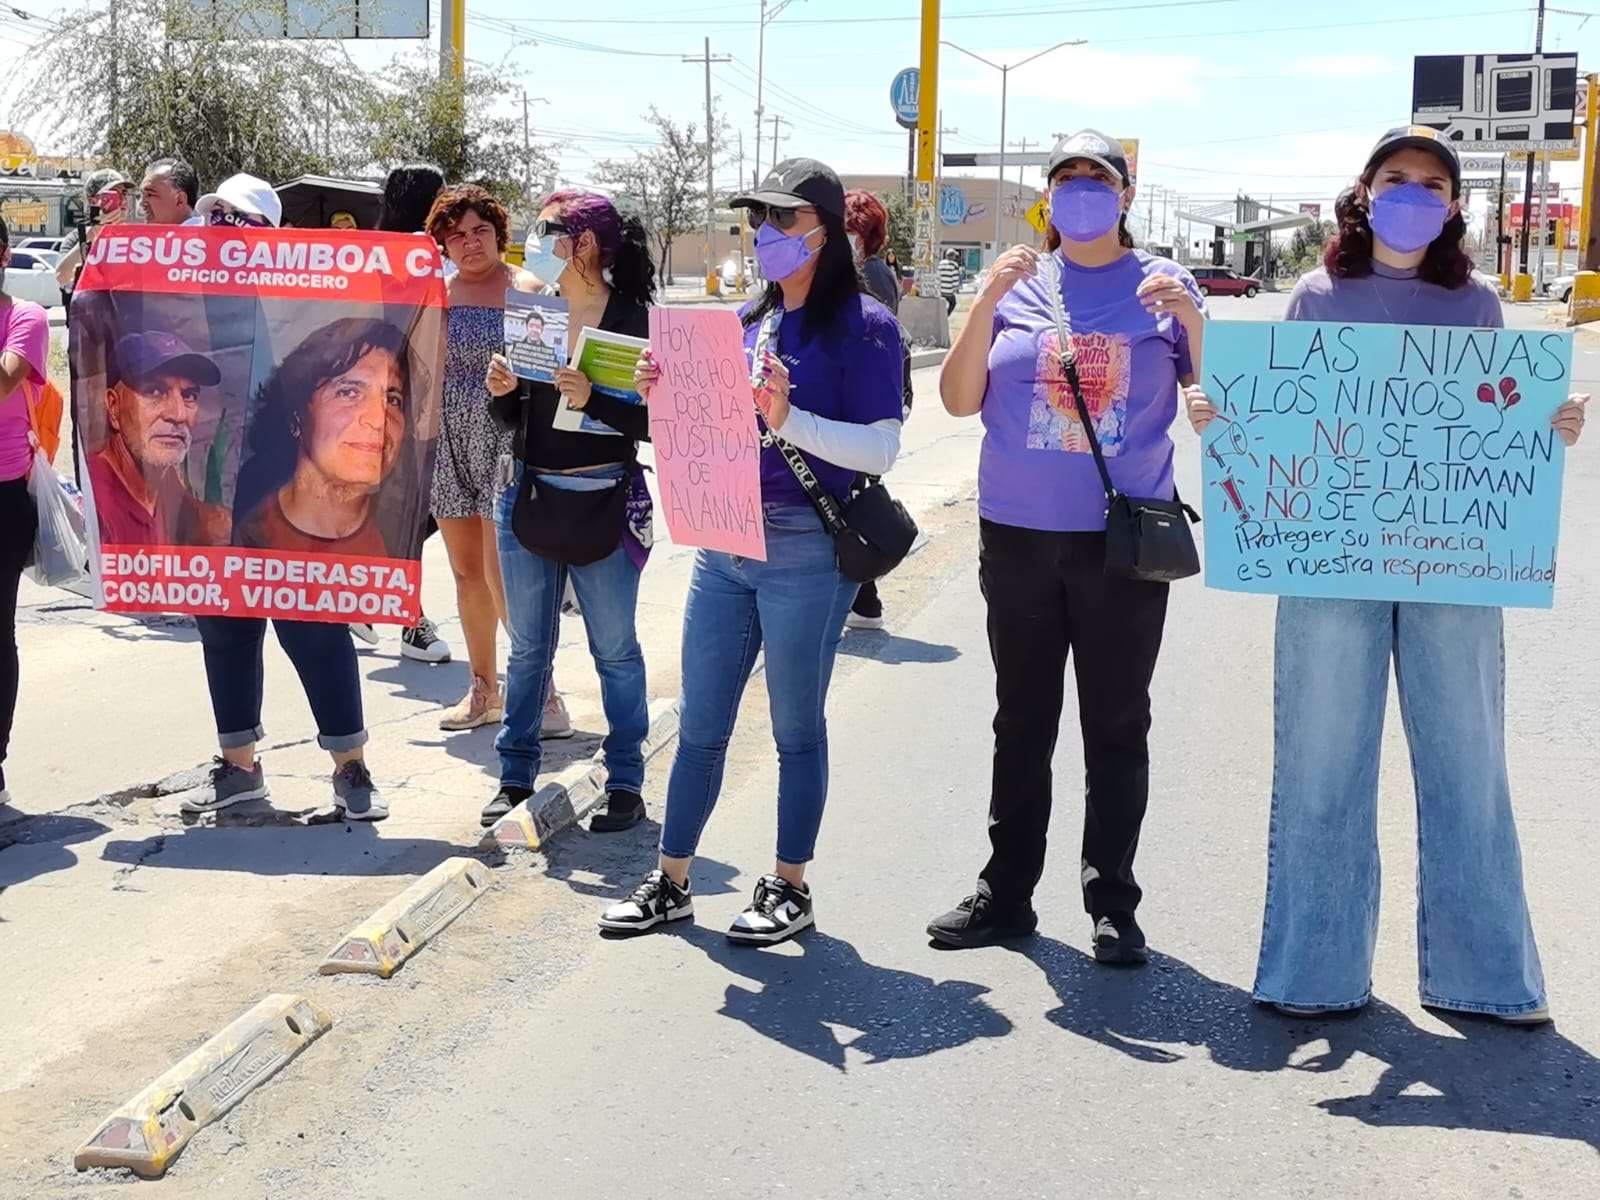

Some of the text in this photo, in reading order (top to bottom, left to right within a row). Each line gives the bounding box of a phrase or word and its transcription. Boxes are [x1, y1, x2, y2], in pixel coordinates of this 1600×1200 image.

[87, 231, 444, 278] JESÚS GAMBOA C.
[168, 268, 349, 290] OFICIO CARROCERO
[659, 308, 696, 361] HOY
[1269, 326, 1565, 382] LAS NIÑAS
[659, 357, 737, 391] MARCHO
[673, 391, 744, 423] POR LA
[1212, 374, 1465, 421] Y LOS NIÑOS
[651, 418, 759, 462] JUSTICIA
[1313, 417, 1554, 463] NO SE TOCAN
[789, 455, 817, 490] LOLA
[1268, 453, 1535, 498] NO SE LASTIMAN
[670, 479, 760, 539] ALANNA
[1264, 489, 1507, 530] NO SE CALLAN
[1234, 519, 1484, 554] ¡Proteger su infancia
[223, 556, 415, 595] PEDERASTA,
[1237, 558, 1272, 581] es
[1287, 548, 1373, 576] nuestra
[240, 584, 410, 618] VIOLADOR.
